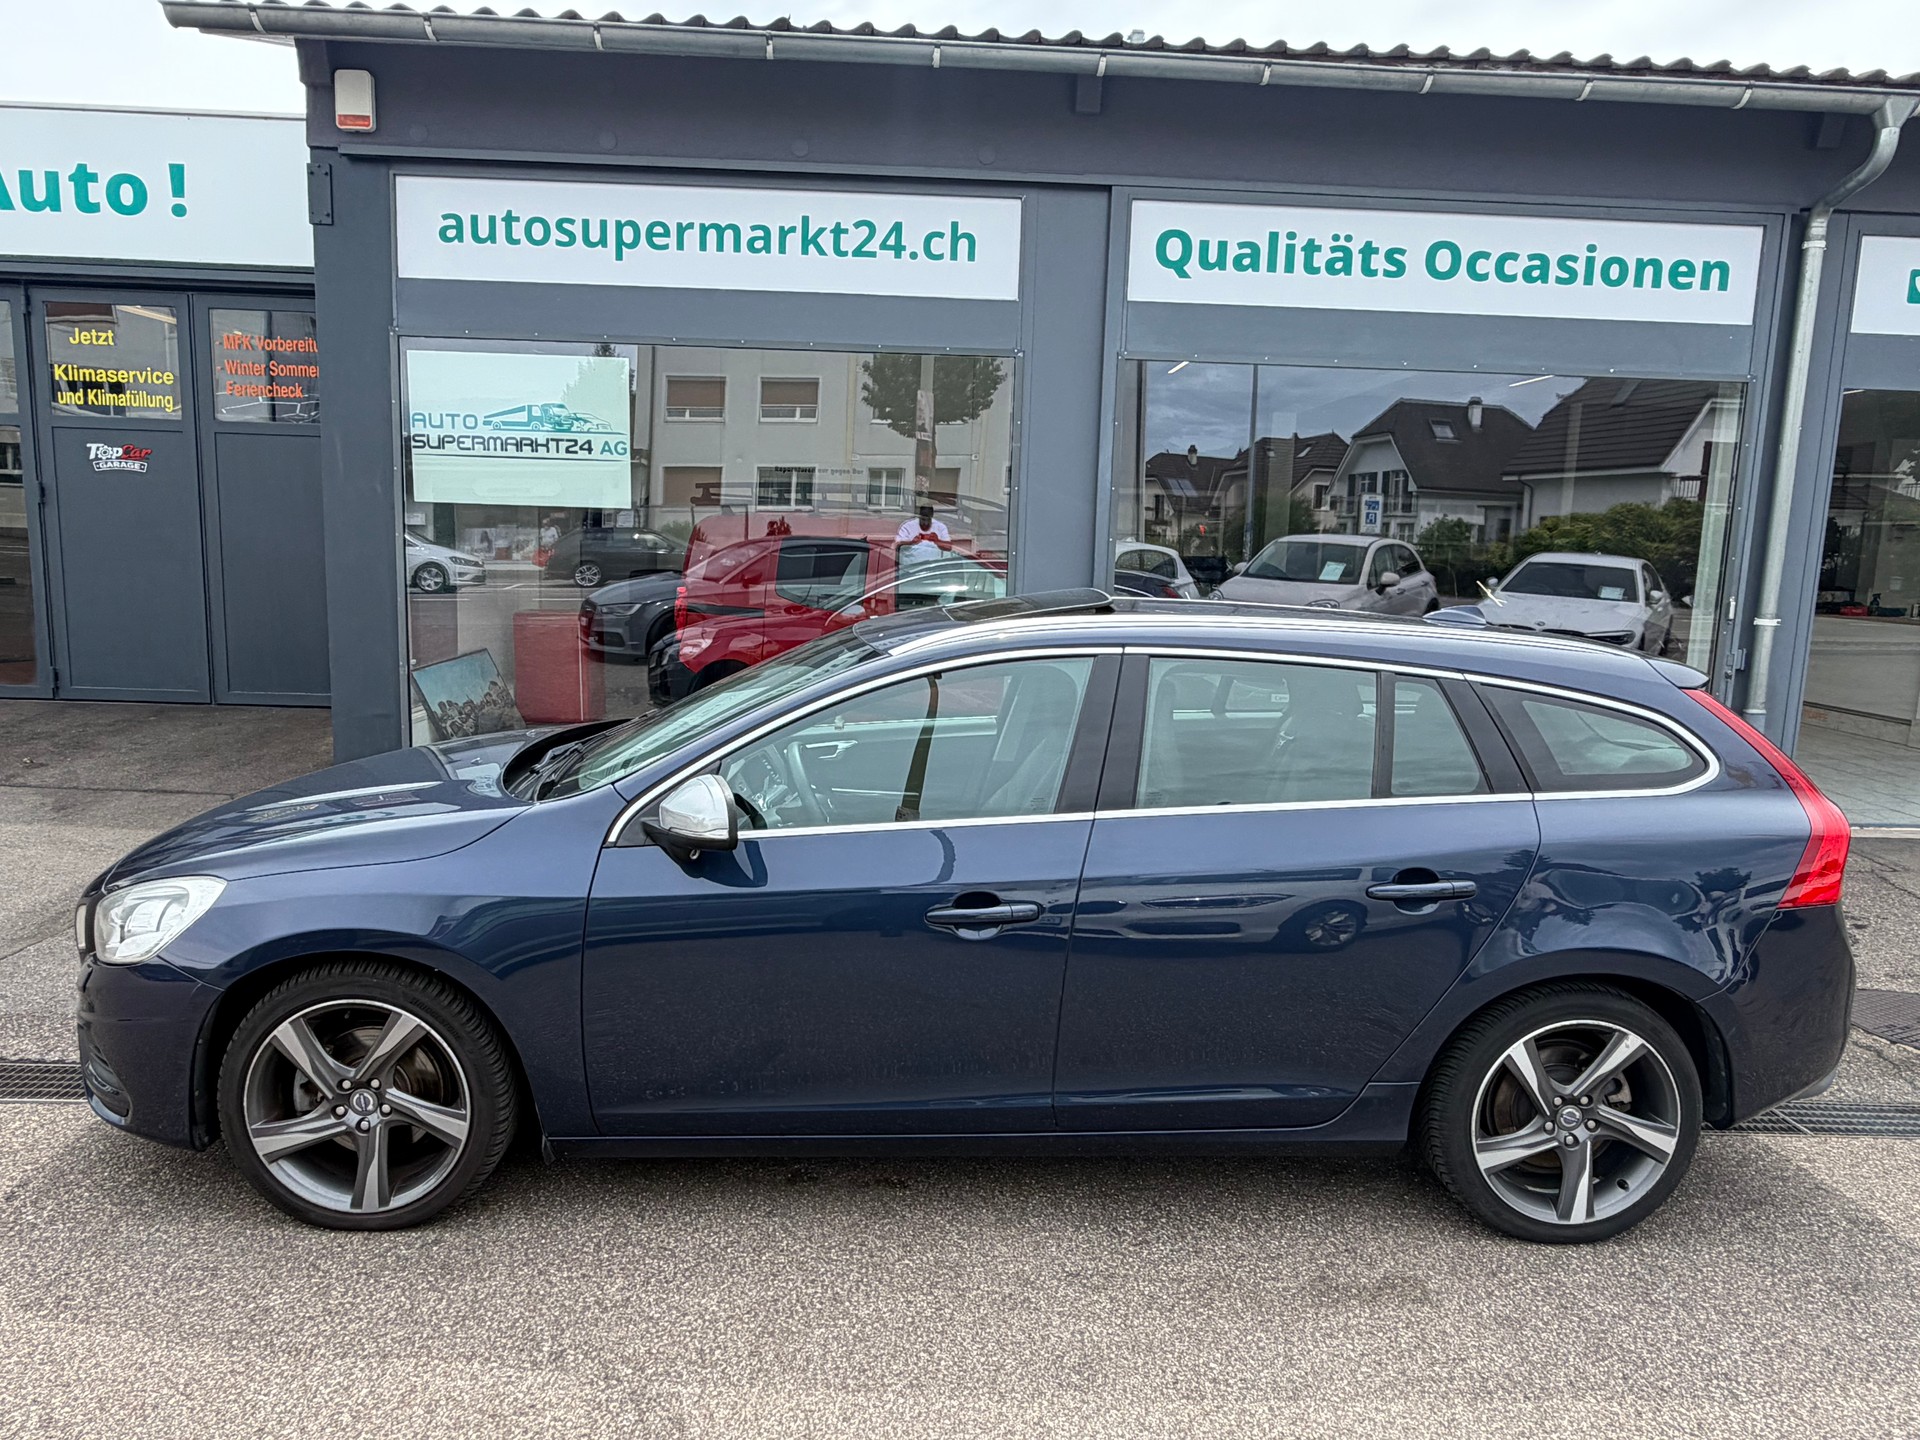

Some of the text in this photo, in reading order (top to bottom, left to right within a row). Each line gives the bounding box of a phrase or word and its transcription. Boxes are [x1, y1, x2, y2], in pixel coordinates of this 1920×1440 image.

[438, 210, 976, 262] autosupermarkt24.ch
[1155, 229, 1730, 292] Qualitäts Occasionen
[69, 327, 114, 346] Jetzt
[223, 333, 253, 351] MFK
[54, 363, 174, 385] Klimaservice
[224, 360, 266, 376] Winter
[225, 381, 304, 398] Feriencheck
[57, 388, 173, 413] und Klimafüllung
[411, 412, 478, 430] AUTO
[412, 433, 628, 455] SUPERMARKT24 AG
[99, 461, 141, 471] GARAGE
